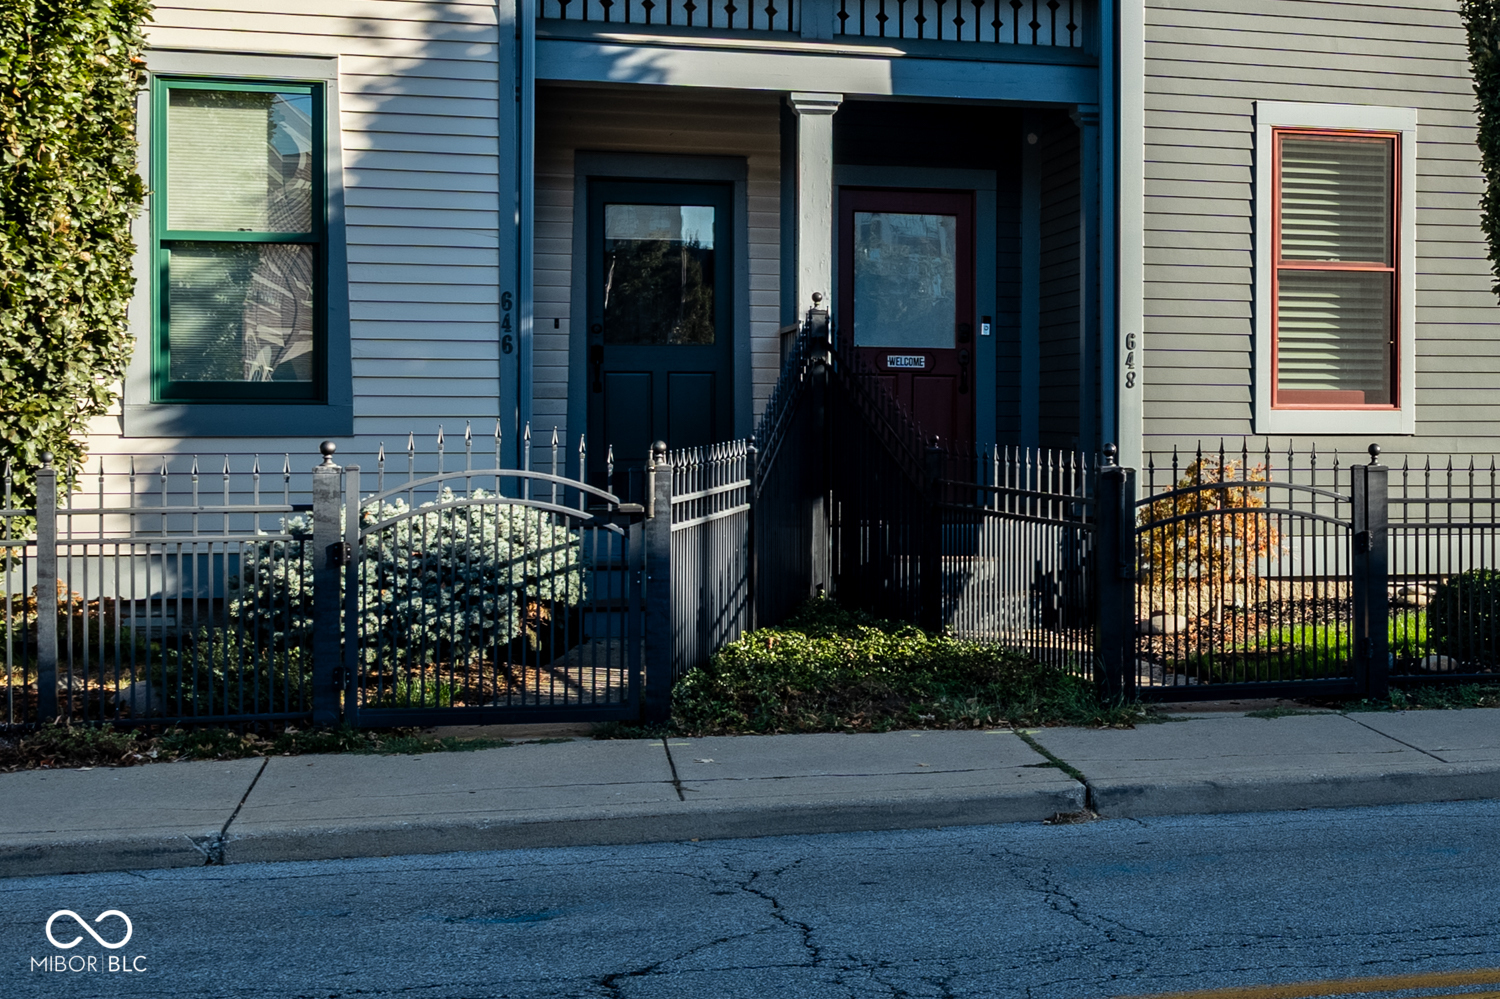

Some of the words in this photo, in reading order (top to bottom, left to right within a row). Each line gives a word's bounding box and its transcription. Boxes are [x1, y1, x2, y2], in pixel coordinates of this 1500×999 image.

[501, 291, 513, 354] 646
[888, 356, 924, 367] WELCOME
[1125, 332, 1136, 388] 648
